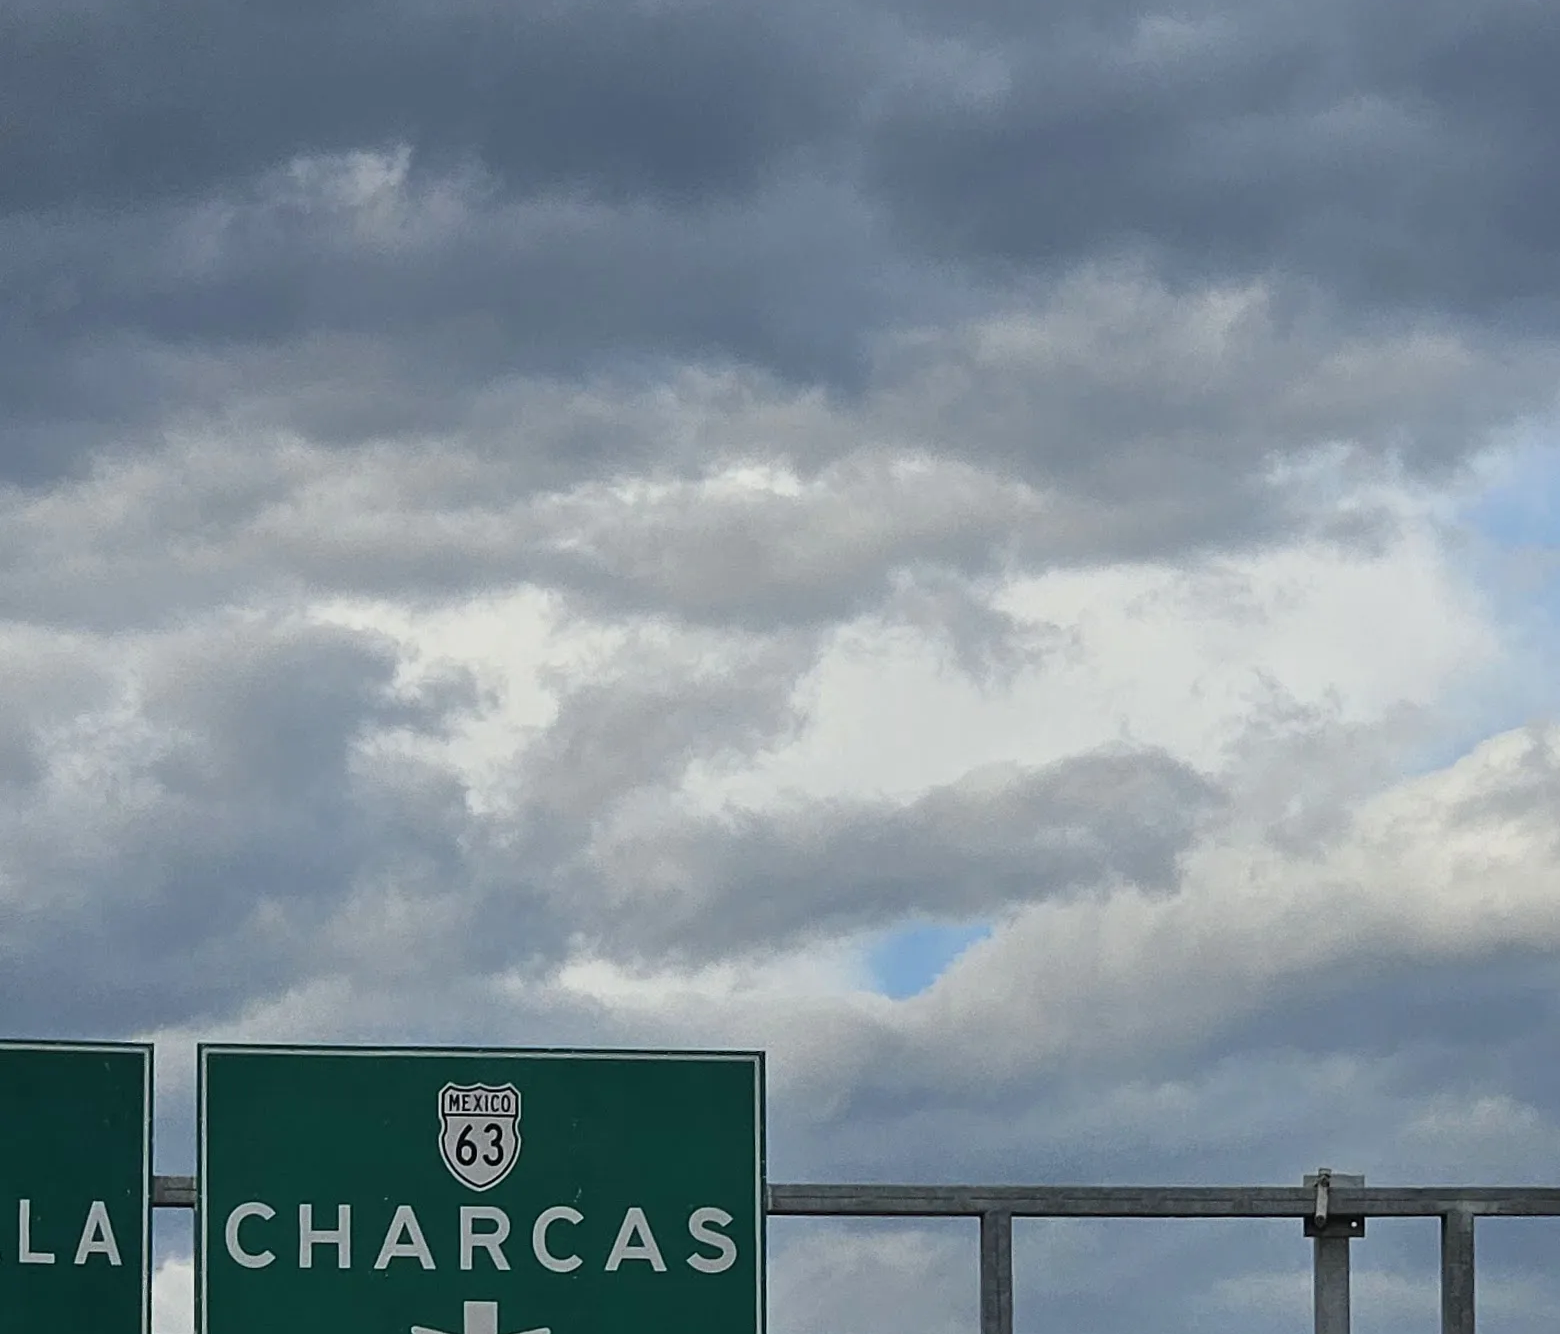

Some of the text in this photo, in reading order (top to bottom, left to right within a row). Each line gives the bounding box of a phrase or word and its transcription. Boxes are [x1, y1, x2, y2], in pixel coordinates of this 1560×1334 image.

[448, 1094, 511, 1112] MEXICO
[455, 1123, 504, 1167] 63
[19, 1199, 122, 1266] LA
[225, 1201, 738, 1273] CHARCAS
